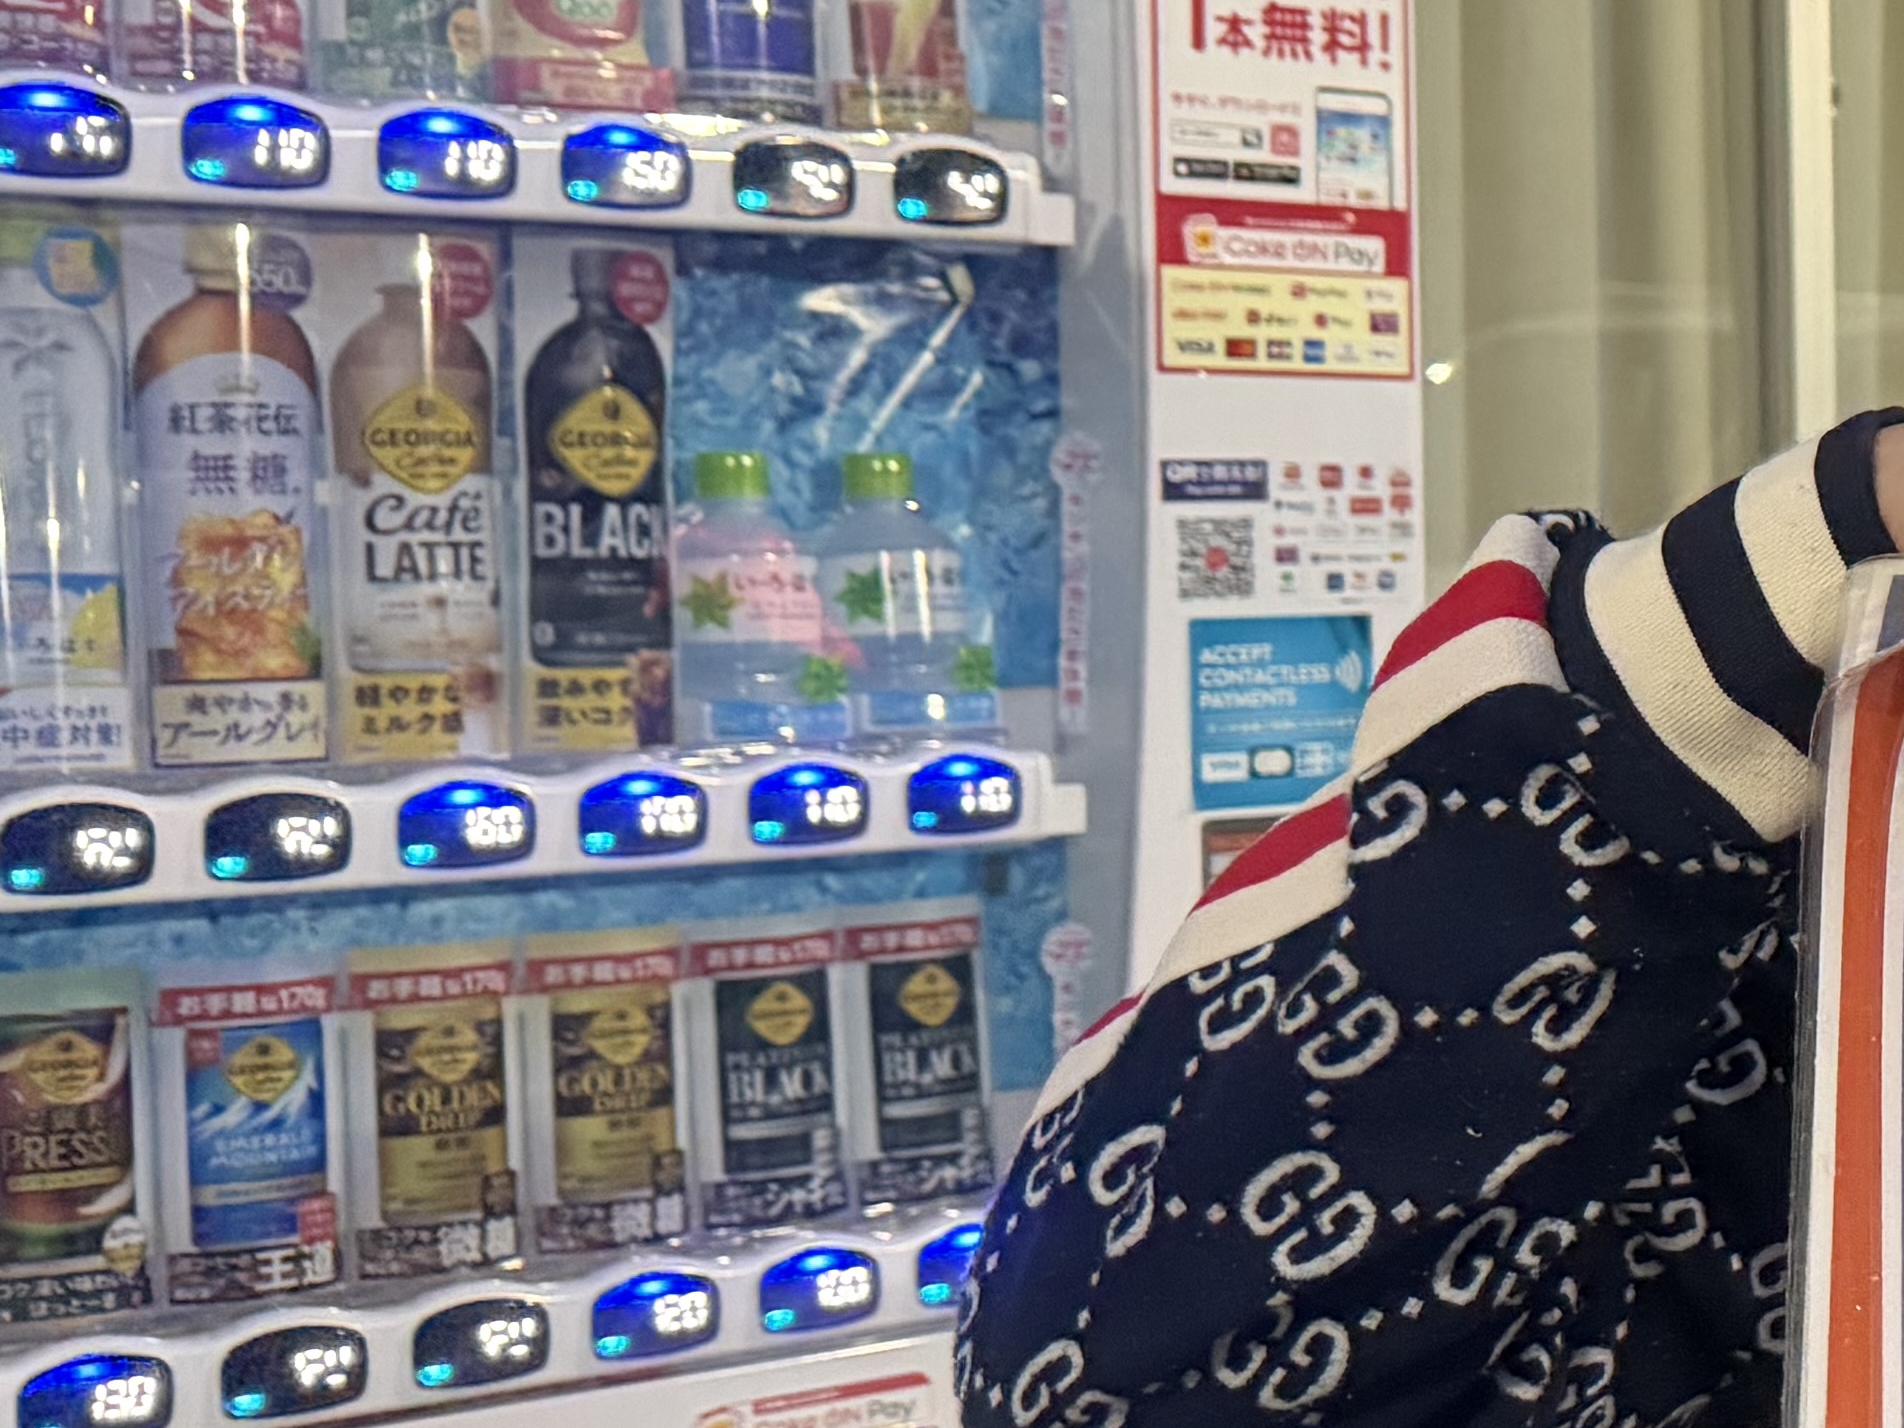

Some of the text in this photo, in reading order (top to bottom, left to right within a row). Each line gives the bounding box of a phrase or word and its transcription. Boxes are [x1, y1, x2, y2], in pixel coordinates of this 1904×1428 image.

[167, 400, 303, 437] 紅茶花伝
[364, 540, 488, 584] LATTE
[1199, 641, 1274, 666] ACCEPT
[1199, 662, 1333, 689] CONTACTLESS
[1199, 687, 1298, 710] PAYMENTS
